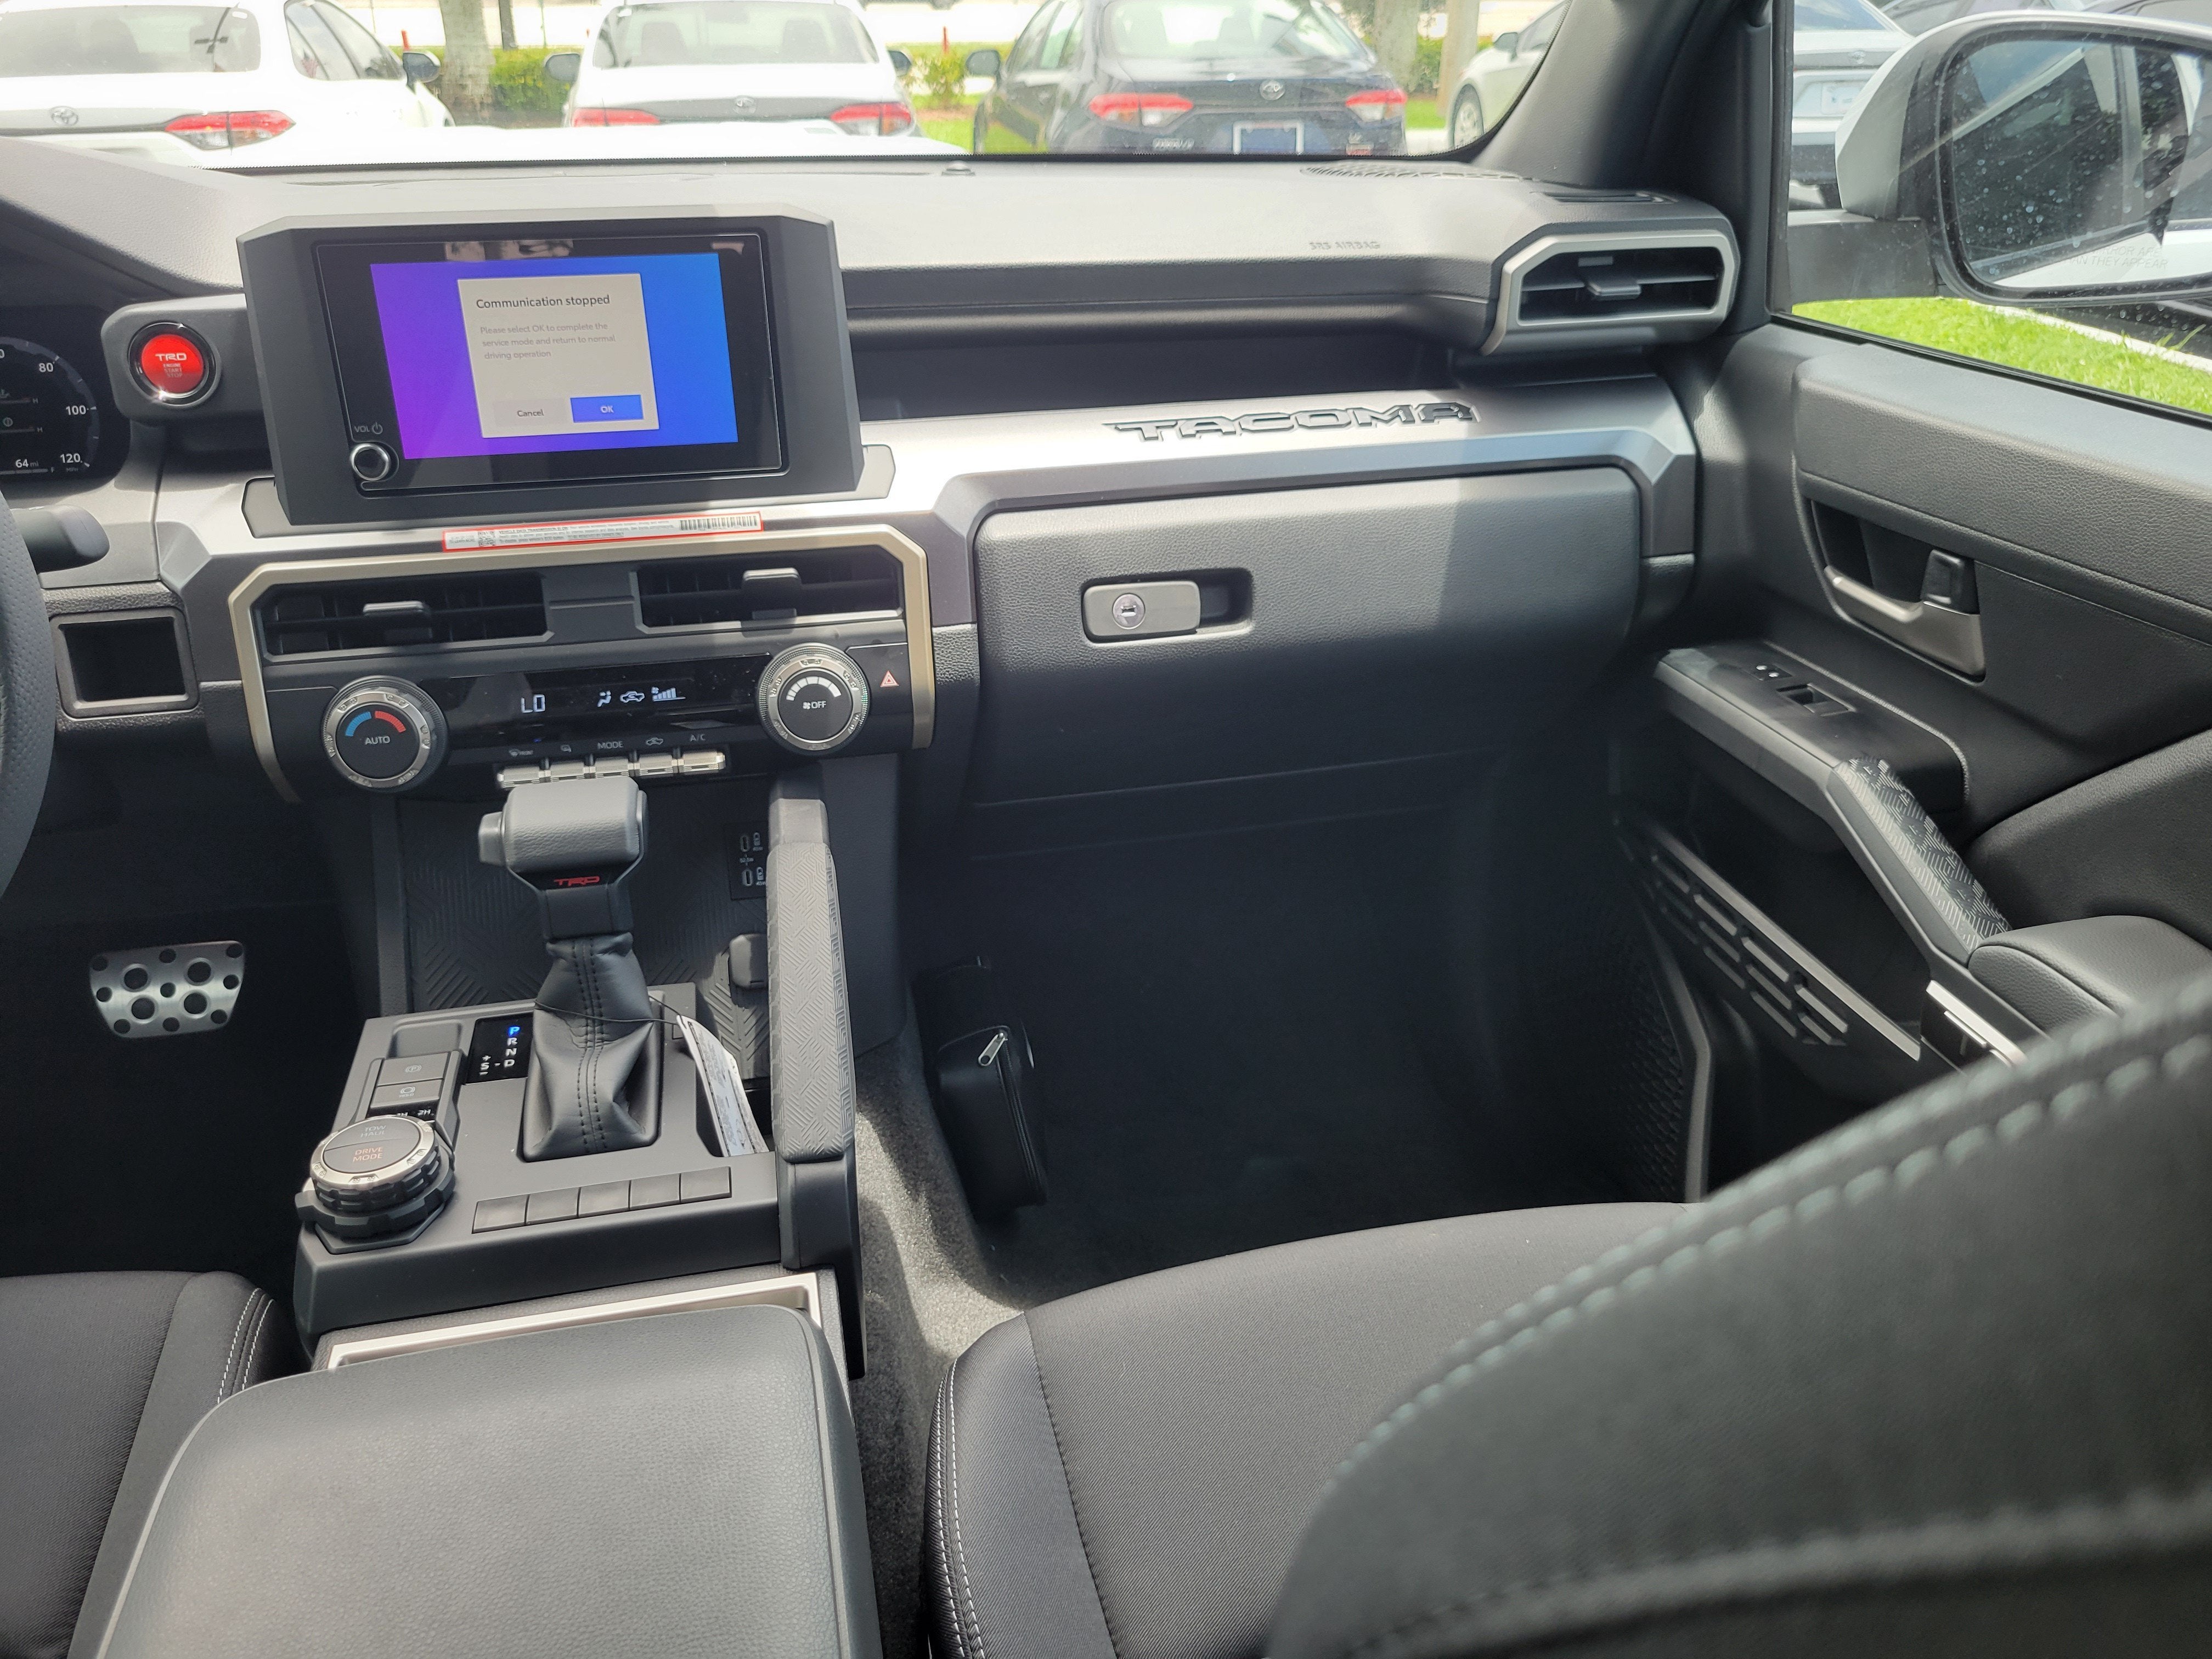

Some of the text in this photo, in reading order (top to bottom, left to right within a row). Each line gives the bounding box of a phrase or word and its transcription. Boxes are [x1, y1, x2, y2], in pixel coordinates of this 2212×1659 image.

[476, 294, 611, 309] Communication stopped
[480, 326, 506, 335] Please
[507, 325, 531, 334] select
[532, 324, 545, 332] OK
[556, 323, 594, 334] complete
[595, 322, 608, 330] the
[482, 334, 616, 347] service mode and return to normal
[155, 352, 187, 362] TRD
[484, 350, 551, 360] driving operation
[38, 362, 54, 373] 80
[65, 405, 87, 415] 100
[517, 405, 614, 417] Cancel OK
[1102, 401, 1481, 442] TACOMA
[353, 425, 370, 433] VOL
[15, 459, 29, 468] 64
[60, 453, 81, 464] 120
[811, 700, 827, 709] OFF
[365, 736, 391, 746] AUTO
[689, 733, 706, 742] A/C
[597, 741, 623, 750] MODE
[553, 876, 600, 887] TRD
[509, 1026, 520, 1036] P
[506, 1037, 518, 1046] R
[505, 1047, 517, 1057] N
[480, 1059, 515, 1071] S D
[354, 1146, 383, 1155] DRIVE
[353, 1153, 383, 1163] MODE
